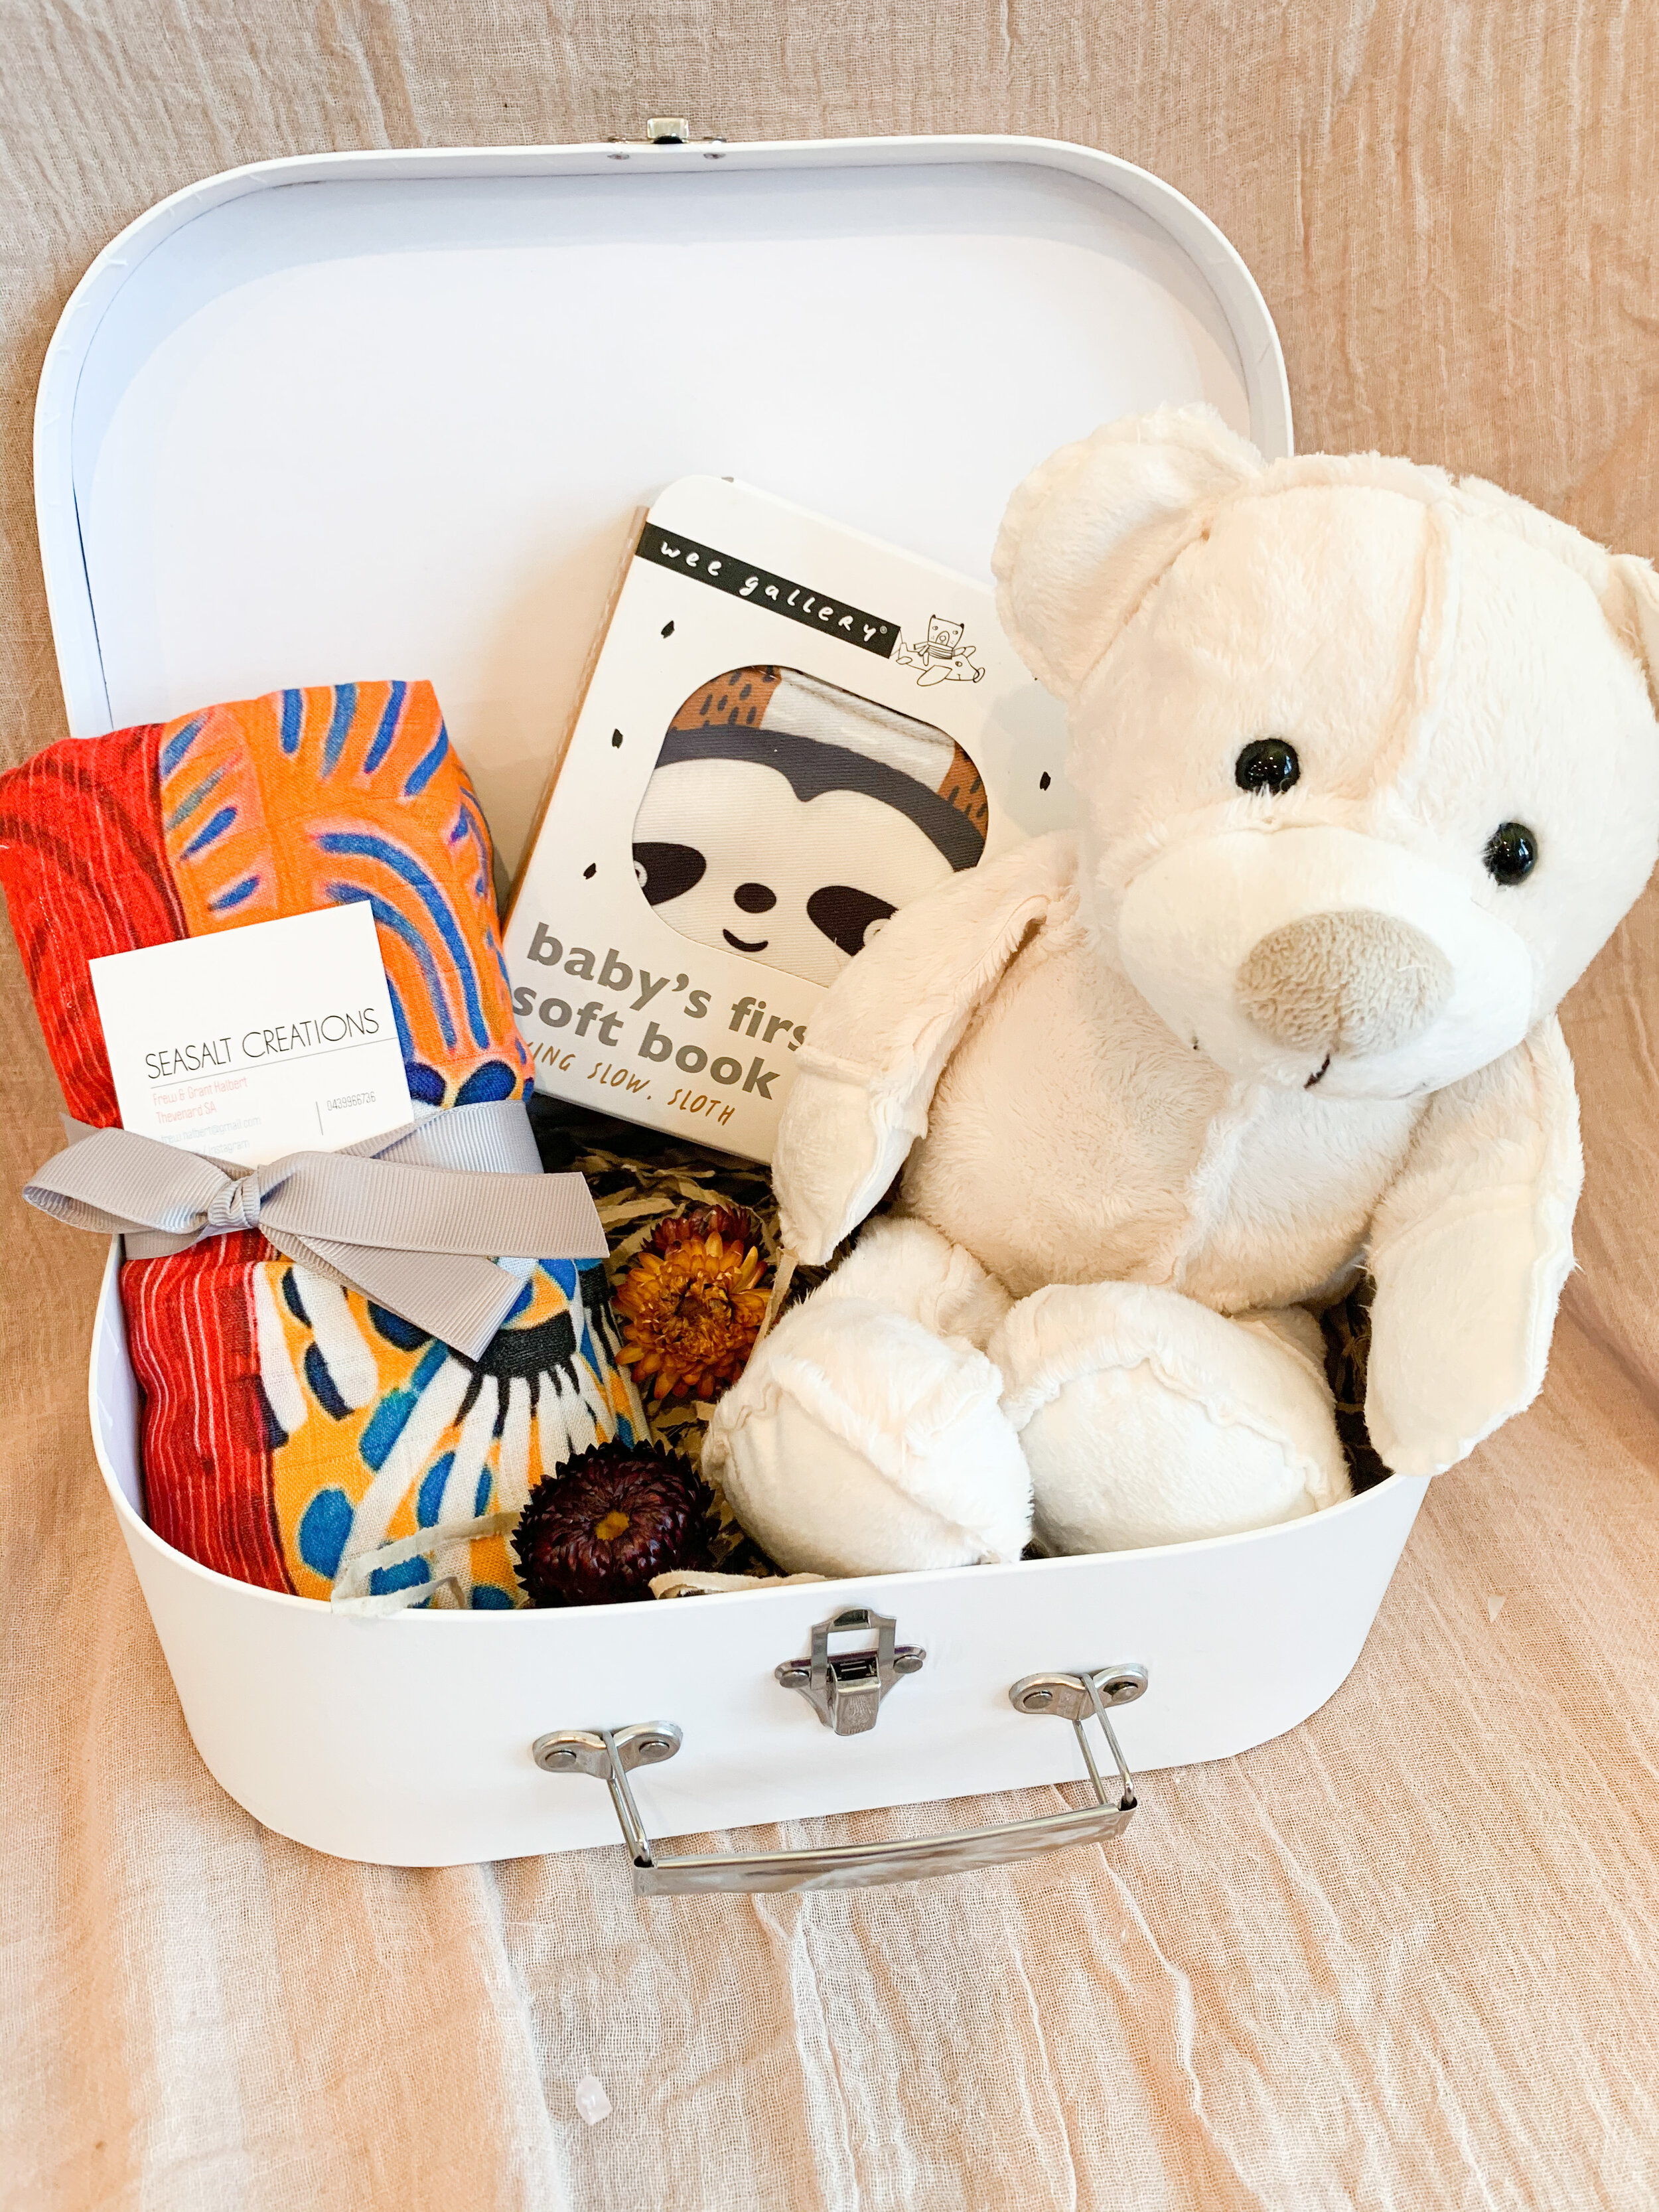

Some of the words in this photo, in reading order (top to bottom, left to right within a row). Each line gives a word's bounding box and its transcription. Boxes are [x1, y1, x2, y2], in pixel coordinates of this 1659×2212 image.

[660, 541, 722, 577] wee
[526, 922, 712, 1019] baby’s
[728, 996, 808, 1052] firs
[145, 1037, 233, 1080] SEASALT
[242, 1008, 380, 1059] CREATIONS
[512, 986, 624, 1047] soft
[638, 1022, 780, 1100] book
[153, 1092, 178, 1106] Frew
[188, 1084, 214, 1100] Grant
[214, 1076, 249, 1094] Halbert
[326, 1091, 376, 1111] 0439966736
[528, 1041, 576, 1072] ING
[667, 1088, 736, 1126] SLOTH
[156, 1104, 204, 1125] Thevenard
[204, 1100, 218, 1116] SA
